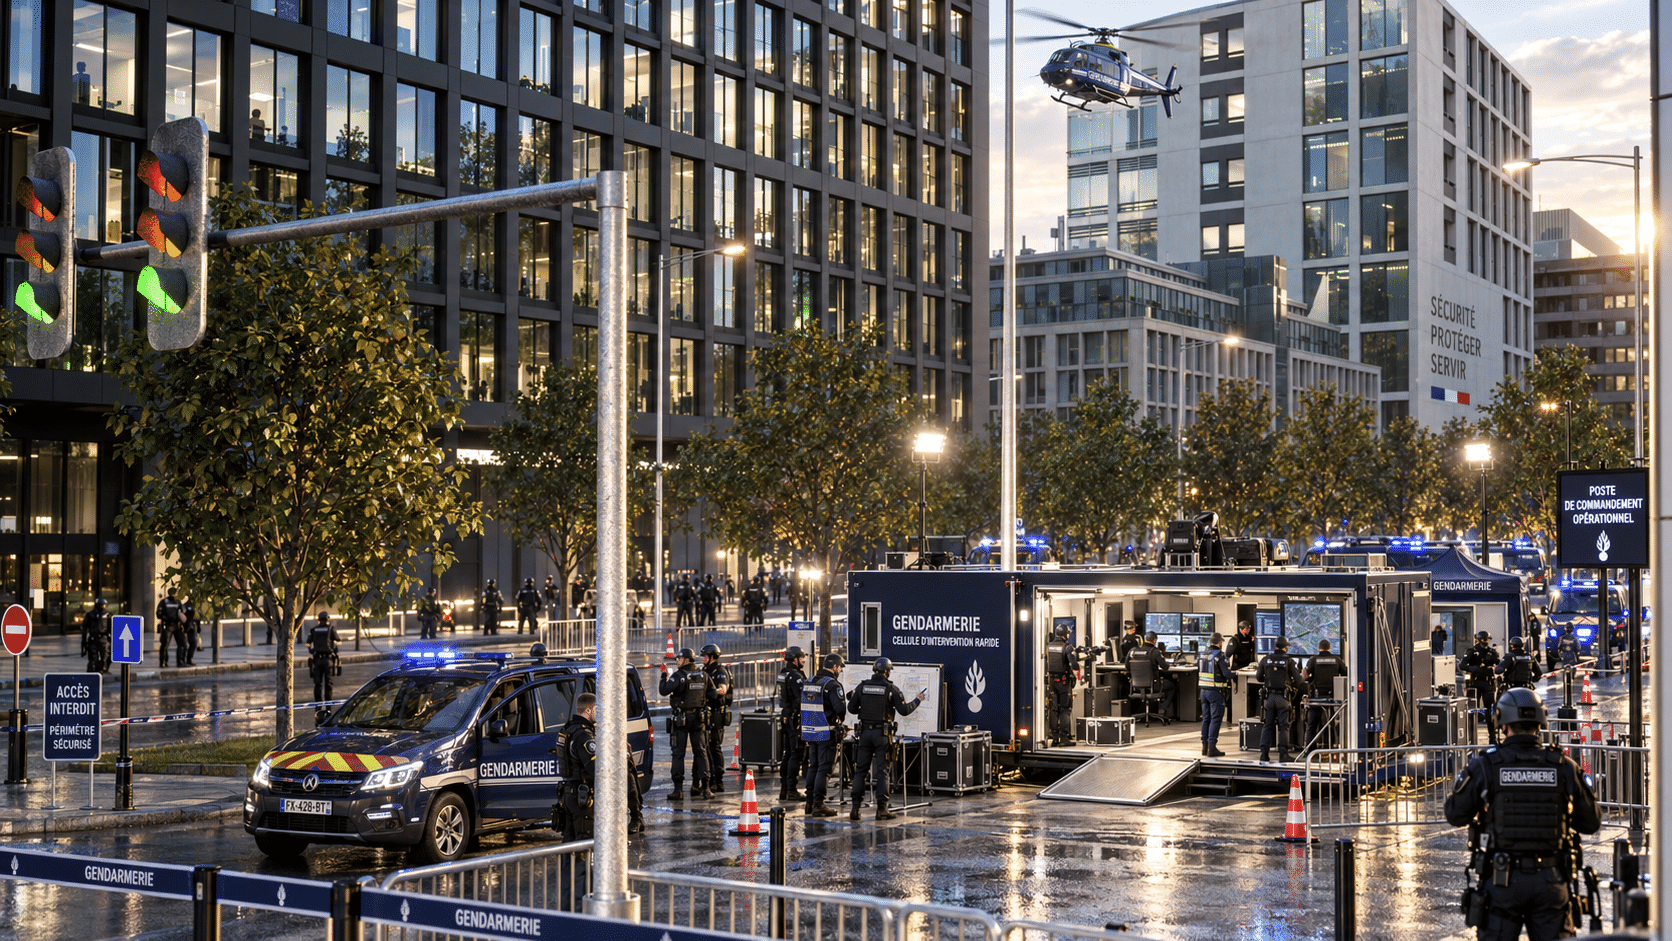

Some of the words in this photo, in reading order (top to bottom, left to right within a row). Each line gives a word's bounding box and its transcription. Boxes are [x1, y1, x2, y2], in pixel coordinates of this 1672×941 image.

[1431, 294, 1475, 329] SÉCURITÉ
[1431, 324, 1481, 357] PROTÉGER
[1431, 353, 1466, 380] SERVIR
[1589, 485, 1616, 496] POSTE
[1564, 500, 1575, 511] DE
[1576, 498, 1644, 510] COMMANDEMENT
[1572, 511, 1635, 525] OPÉRATIONNEL
[1433, 581, 1492, 591] GENDARMERIE
[892, 614, 981, 632] GENDARMERIE
[892, 635, 920, 646] CELLULE
[974, 637, 1000, 648] RAPIDE
[56, 682, 90, 699] ACCÈS
[50, 702, 97, 716] INTERDIT
[53, 737, 92, 750] SÉCURISÉ
[480, 760, 555, 778] GENDARMERIE
[285, 800, 326, 814] FX-428-BT
[84, 865, 154, 887] GENDARMERIE
[455, 908, 541, 936] GENDARMERIE
